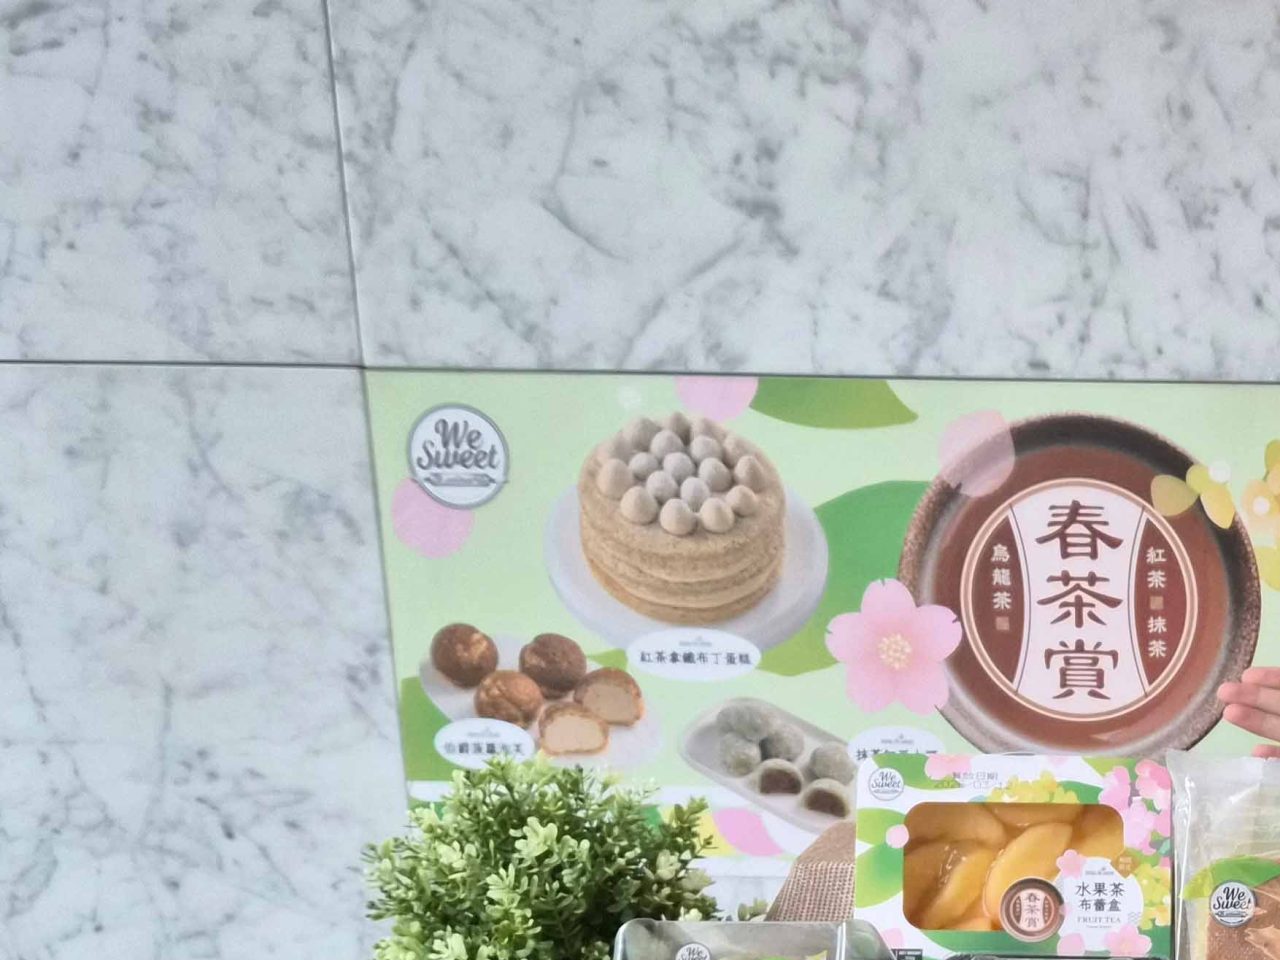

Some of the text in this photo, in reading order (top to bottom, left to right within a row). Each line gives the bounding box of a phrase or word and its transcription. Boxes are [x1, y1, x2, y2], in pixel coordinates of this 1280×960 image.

[434, 418, 483, 450] We
[416, 439, 498, 470] Sweet
[991, 544, 1012, 610] 烏龍茶
[1035, 500, 1124, 700] 春茶賞
[1075, 882, 1126, 897] 水果茶
[1222, 886, 1246, 900] We
[1078, 898, 1122, 912] 布蕾盒
[1212, 896, 1251, 910] Sweet
[1104, 916, 1121, 924] TEA
